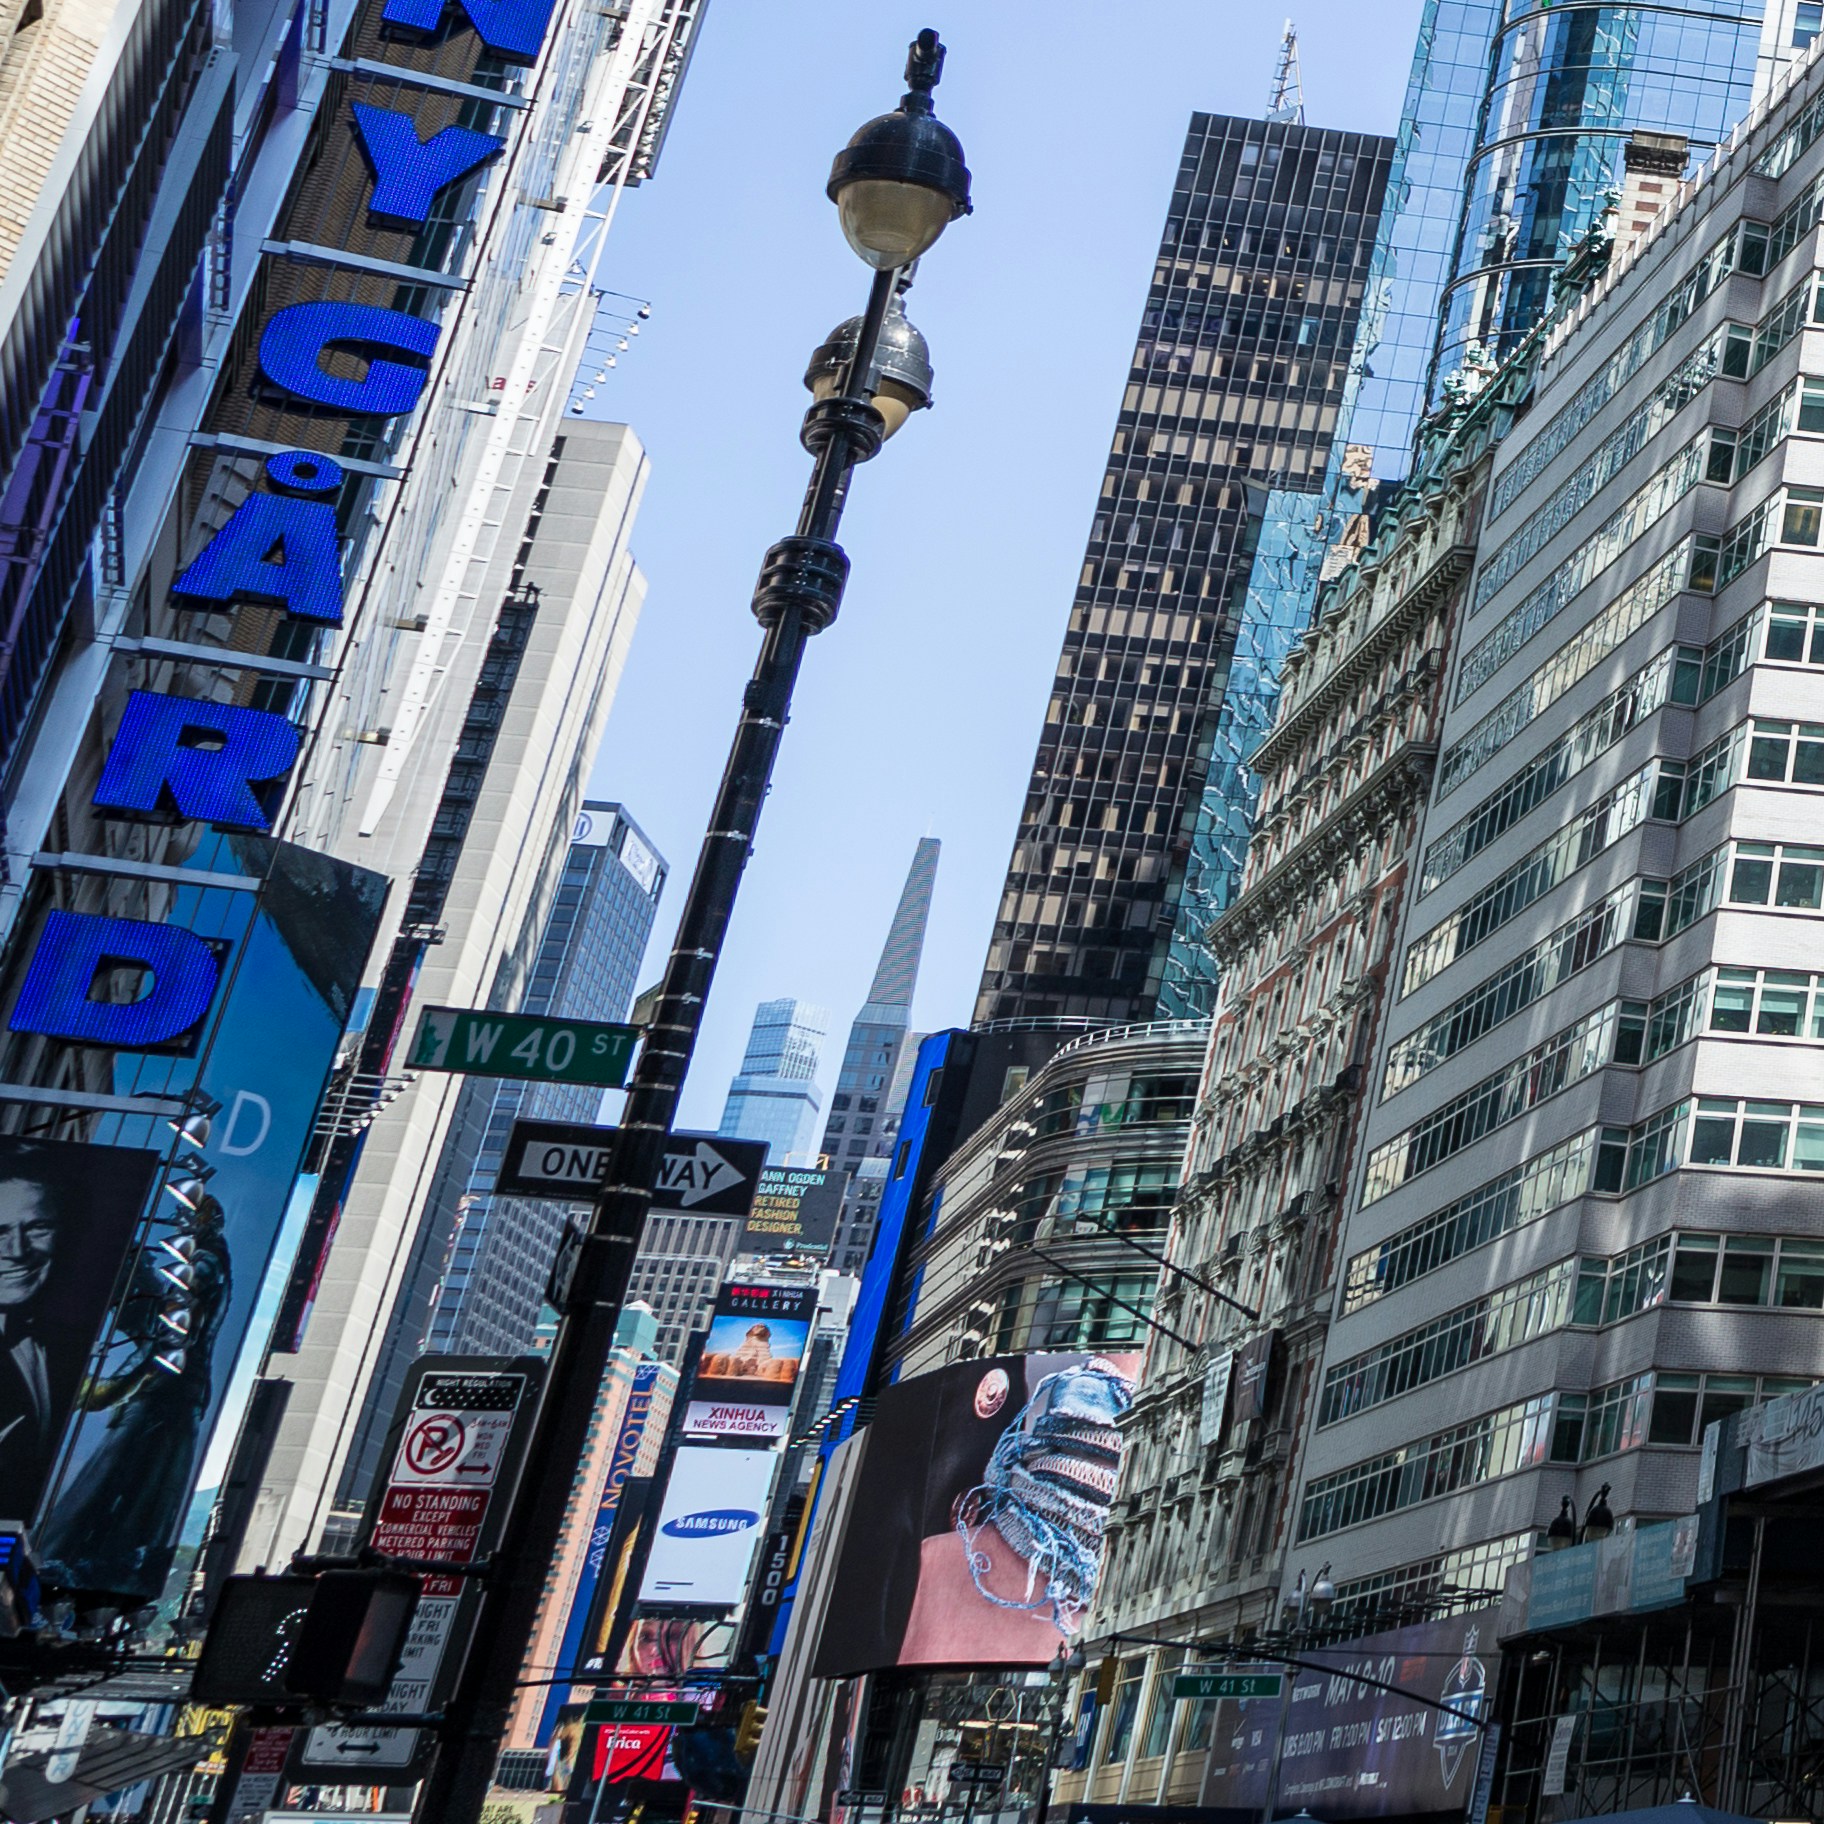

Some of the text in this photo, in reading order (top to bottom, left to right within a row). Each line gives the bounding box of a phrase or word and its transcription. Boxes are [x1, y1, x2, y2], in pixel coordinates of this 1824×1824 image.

[466, 1021, 627, 1072] W 40 ST
[761, 1171, 825, 1186] ANN OGDEN
[758, 1184, 808, 1197] GAFFNEY
[753, 1196, 800, 1208] RETIRED
[751, 1208, 798, 1221] FASHION
[731, 1299, 802, 1311] GALLERY
[708, 1407, 766, 1422] XINHUA
[692, 1419, 778, 1433] NEWS AGENCY
[601, 1381, 656, 1509] NOVOTEL
[392, 1495, 481, 1510] NO STANDING
[412, 1512, 452, 1523] EXCEPT
[675, 1517, 748, 1531] SAMSUNG
[379, 1524, 477, 1536] COMMERCIAL VEHICLES
[377, 1536, 471, 1550] METERED PARKING
[430, 1580, 452, 1592] FRI
[1200, 1679, 1256, 1693] W 41 St
[613, 1704, 671, 1719] W 41 St
